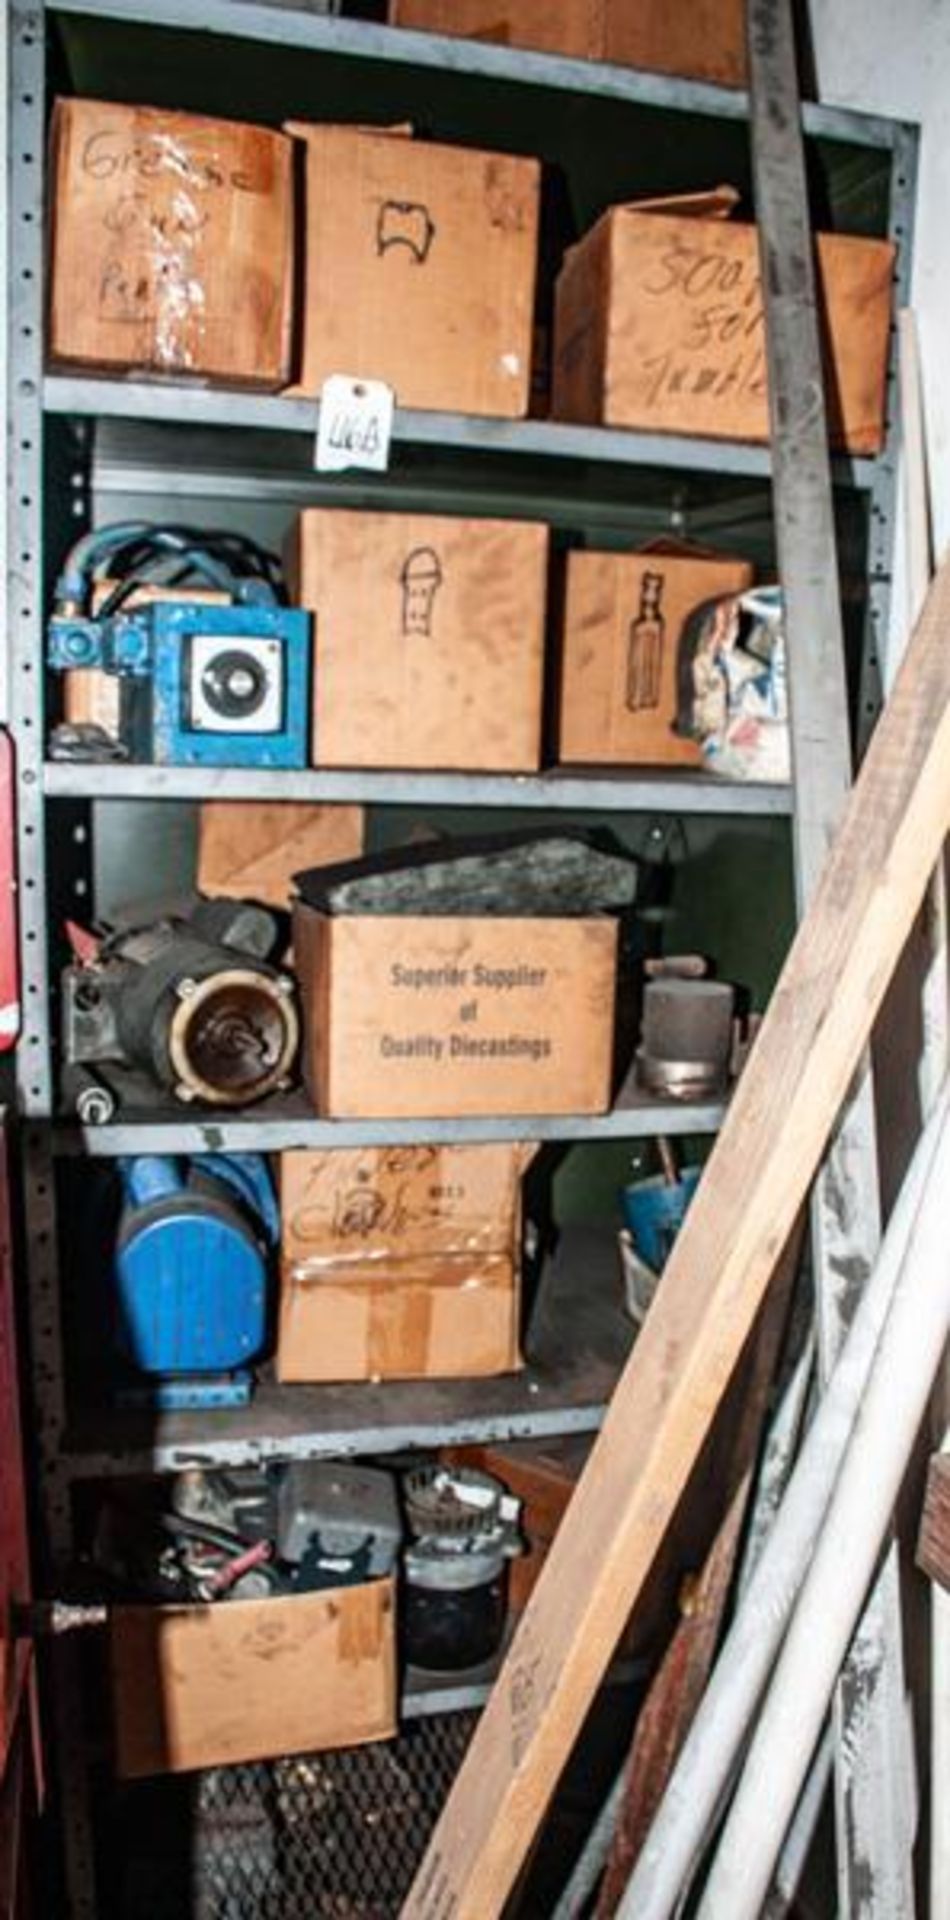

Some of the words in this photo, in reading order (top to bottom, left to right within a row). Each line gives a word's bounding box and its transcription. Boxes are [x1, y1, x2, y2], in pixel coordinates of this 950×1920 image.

[391, 963, 467, 989] Superior
[473, 963, 547, 989] Supplier
[460, 1000, 477, 1022] of
[380, 1034, 443, 1061] Quality
[450, 1034, 552, 1061] Diecastings
